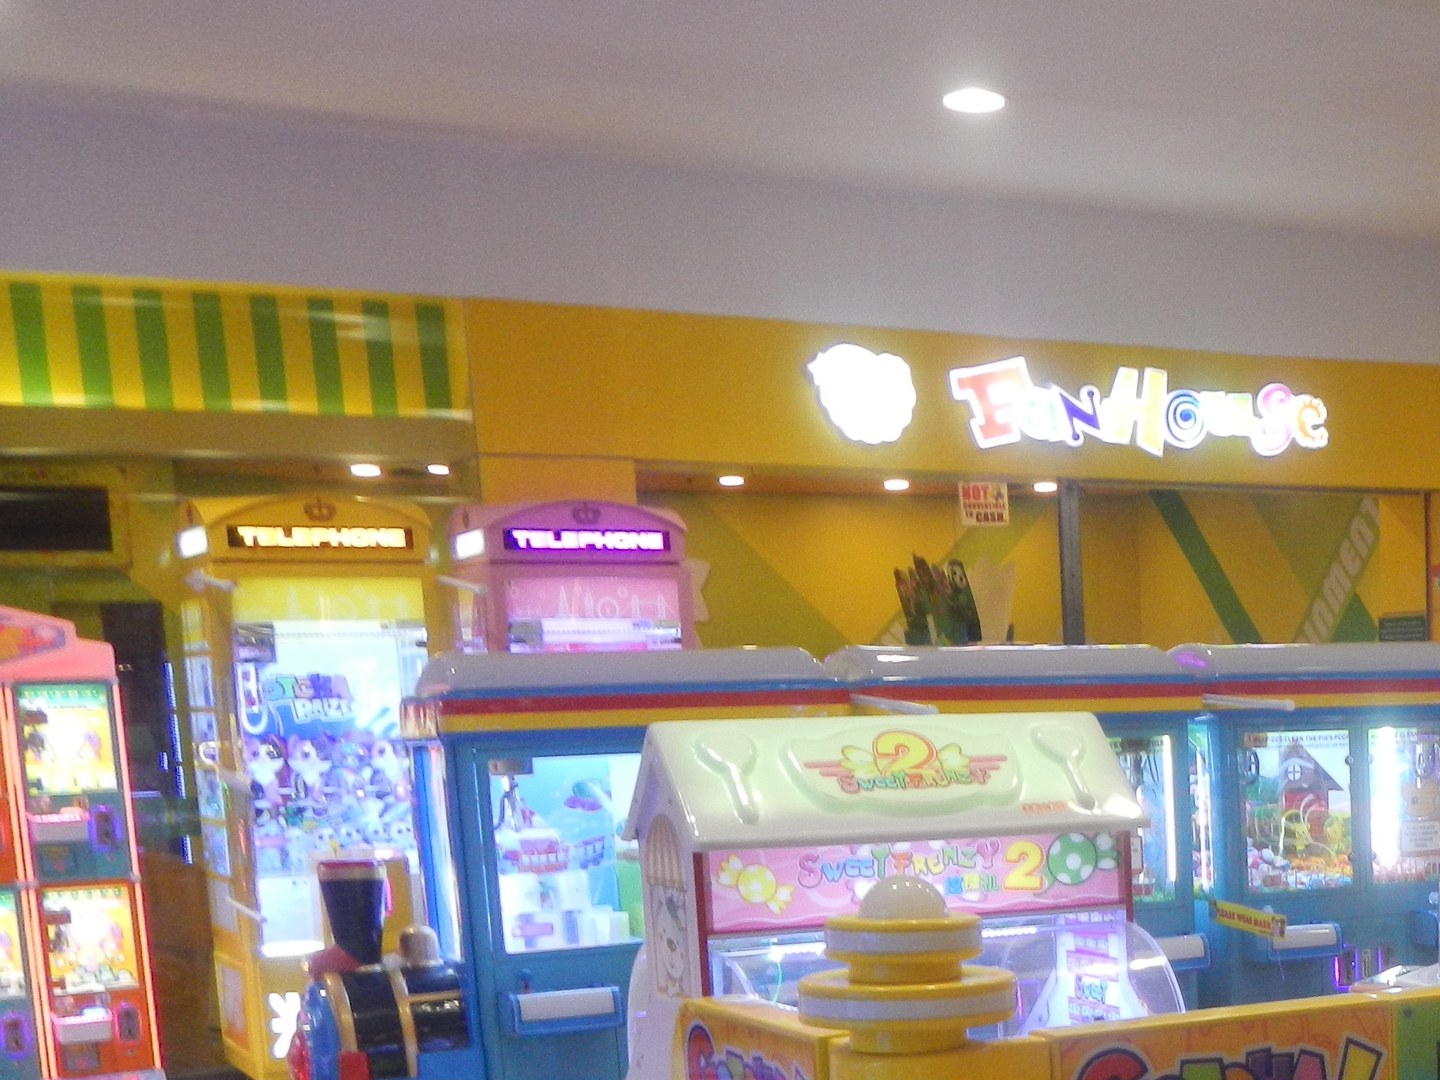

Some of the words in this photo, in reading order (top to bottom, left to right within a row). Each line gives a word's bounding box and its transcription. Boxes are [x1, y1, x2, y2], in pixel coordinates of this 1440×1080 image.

[962, 484, 990, 501] NOT
[236, 526, 407, 549] TELEPHONE
[511, 529, 665, 551] TELEPHONE
[872, 729, 937, 776] 2
[797, 843, 890, 889] SWEET
[889, 837, 1000, 877] FRENZY
[1004, 838, 1046, 893] 2
